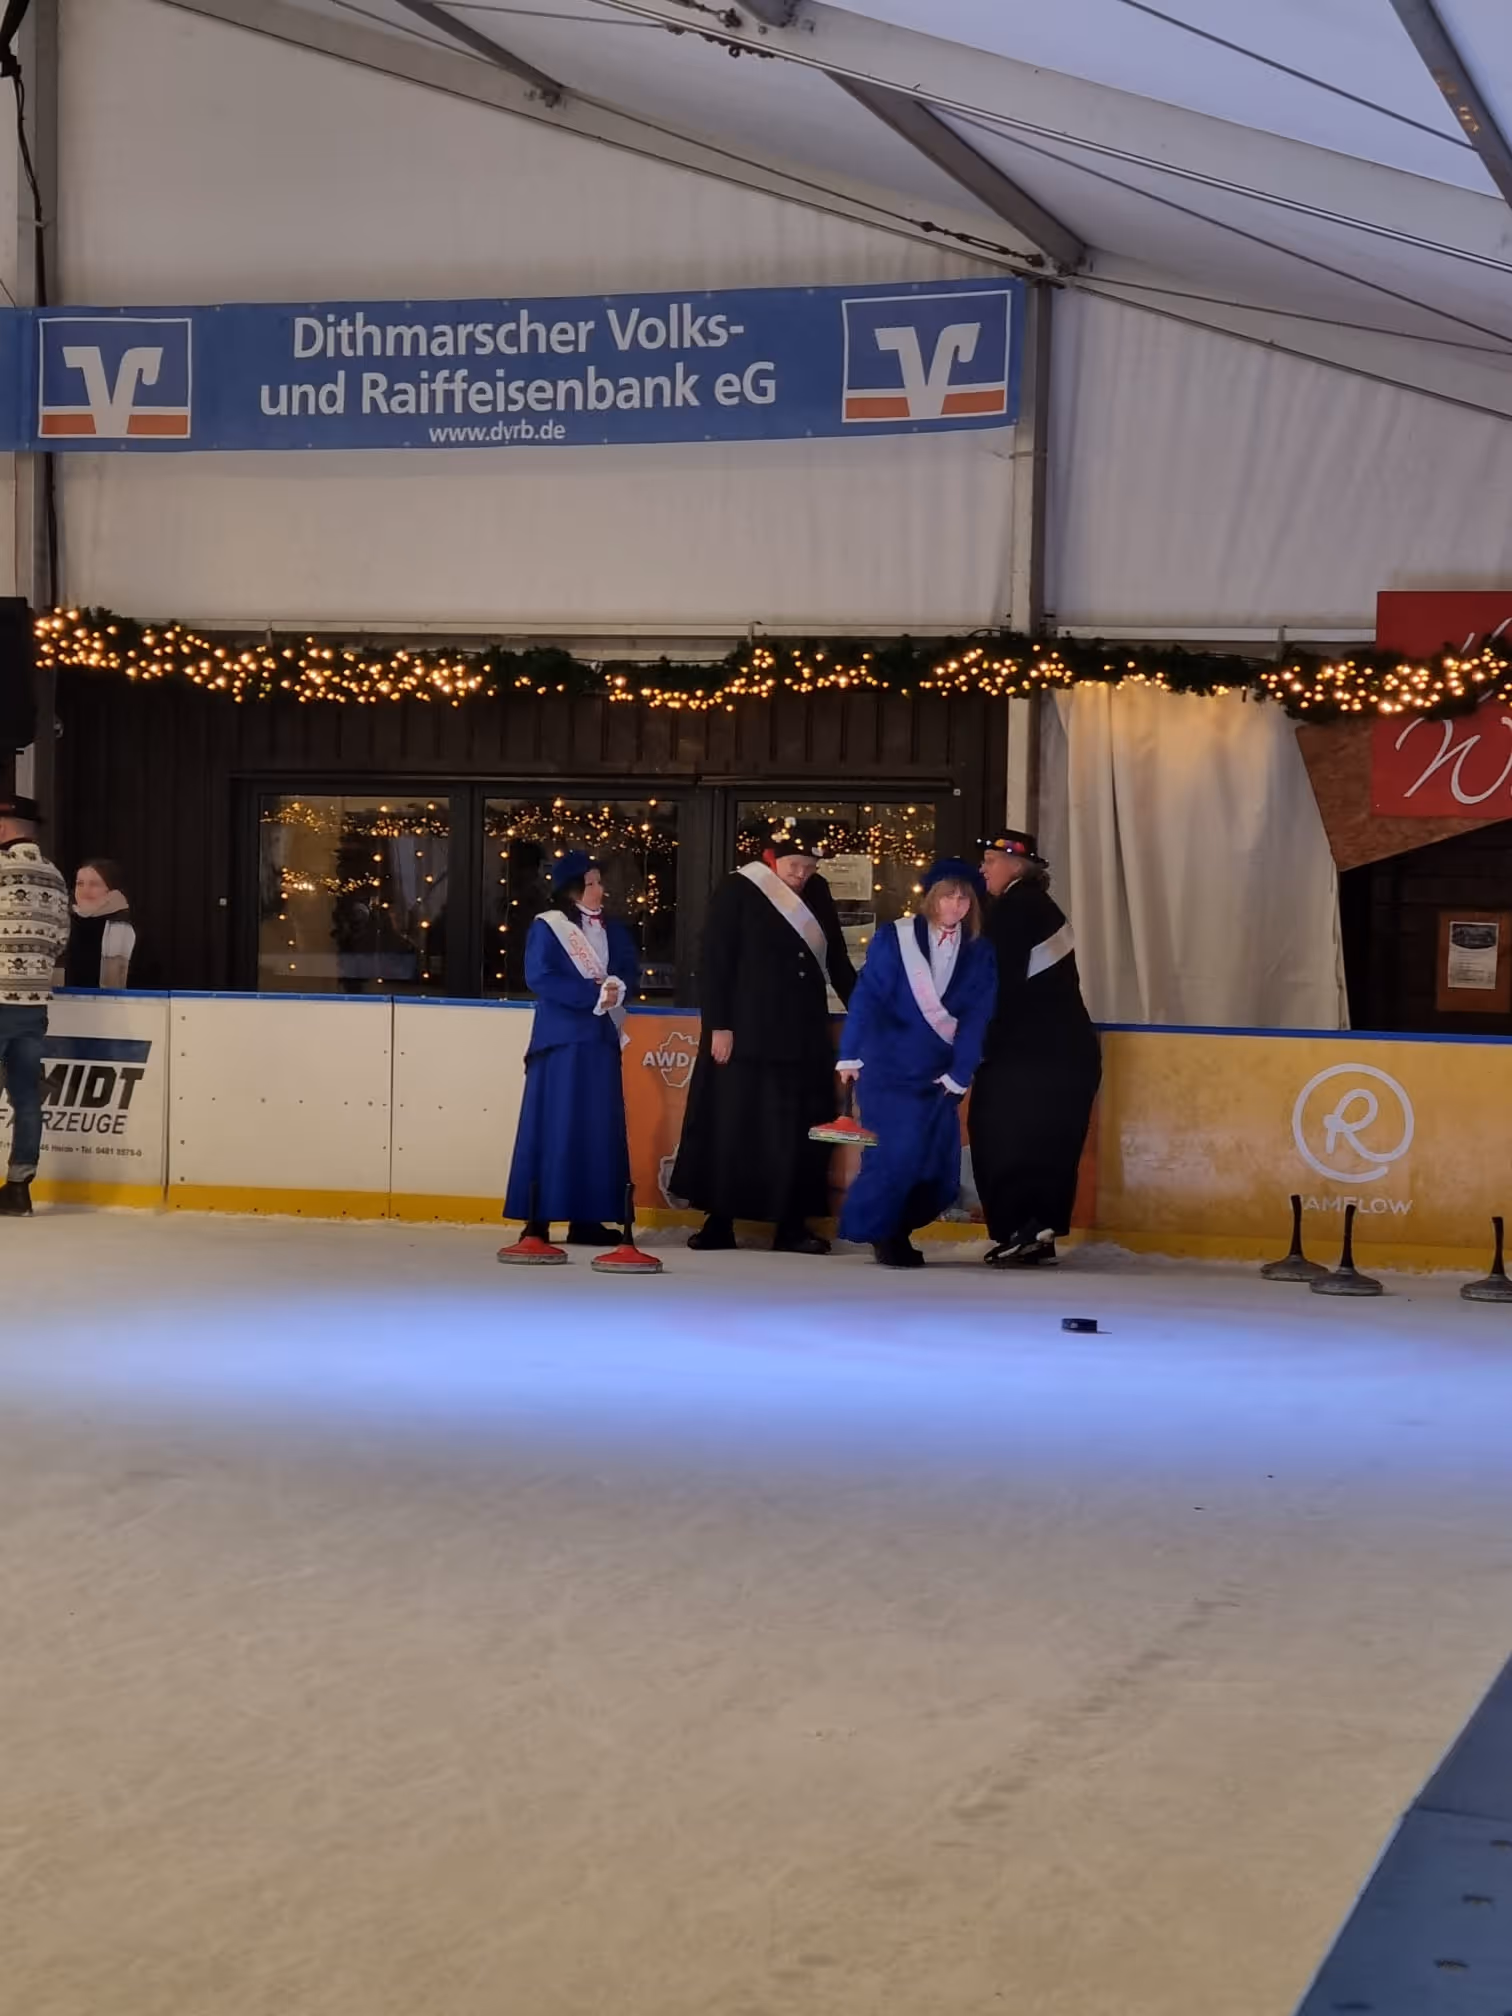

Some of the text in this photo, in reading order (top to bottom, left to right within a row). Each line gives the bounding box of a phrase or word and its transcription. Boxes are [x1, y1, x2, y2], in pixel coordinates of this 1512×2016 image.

[293, 302, 745, 359] Dithmarscher Volks-
[260, 360, 777, 416] und Raiffeisenbank eG
[40, 1063, 145, 1110] MIDT
[1288, 1194, 1413, 1216] AMFLOW
